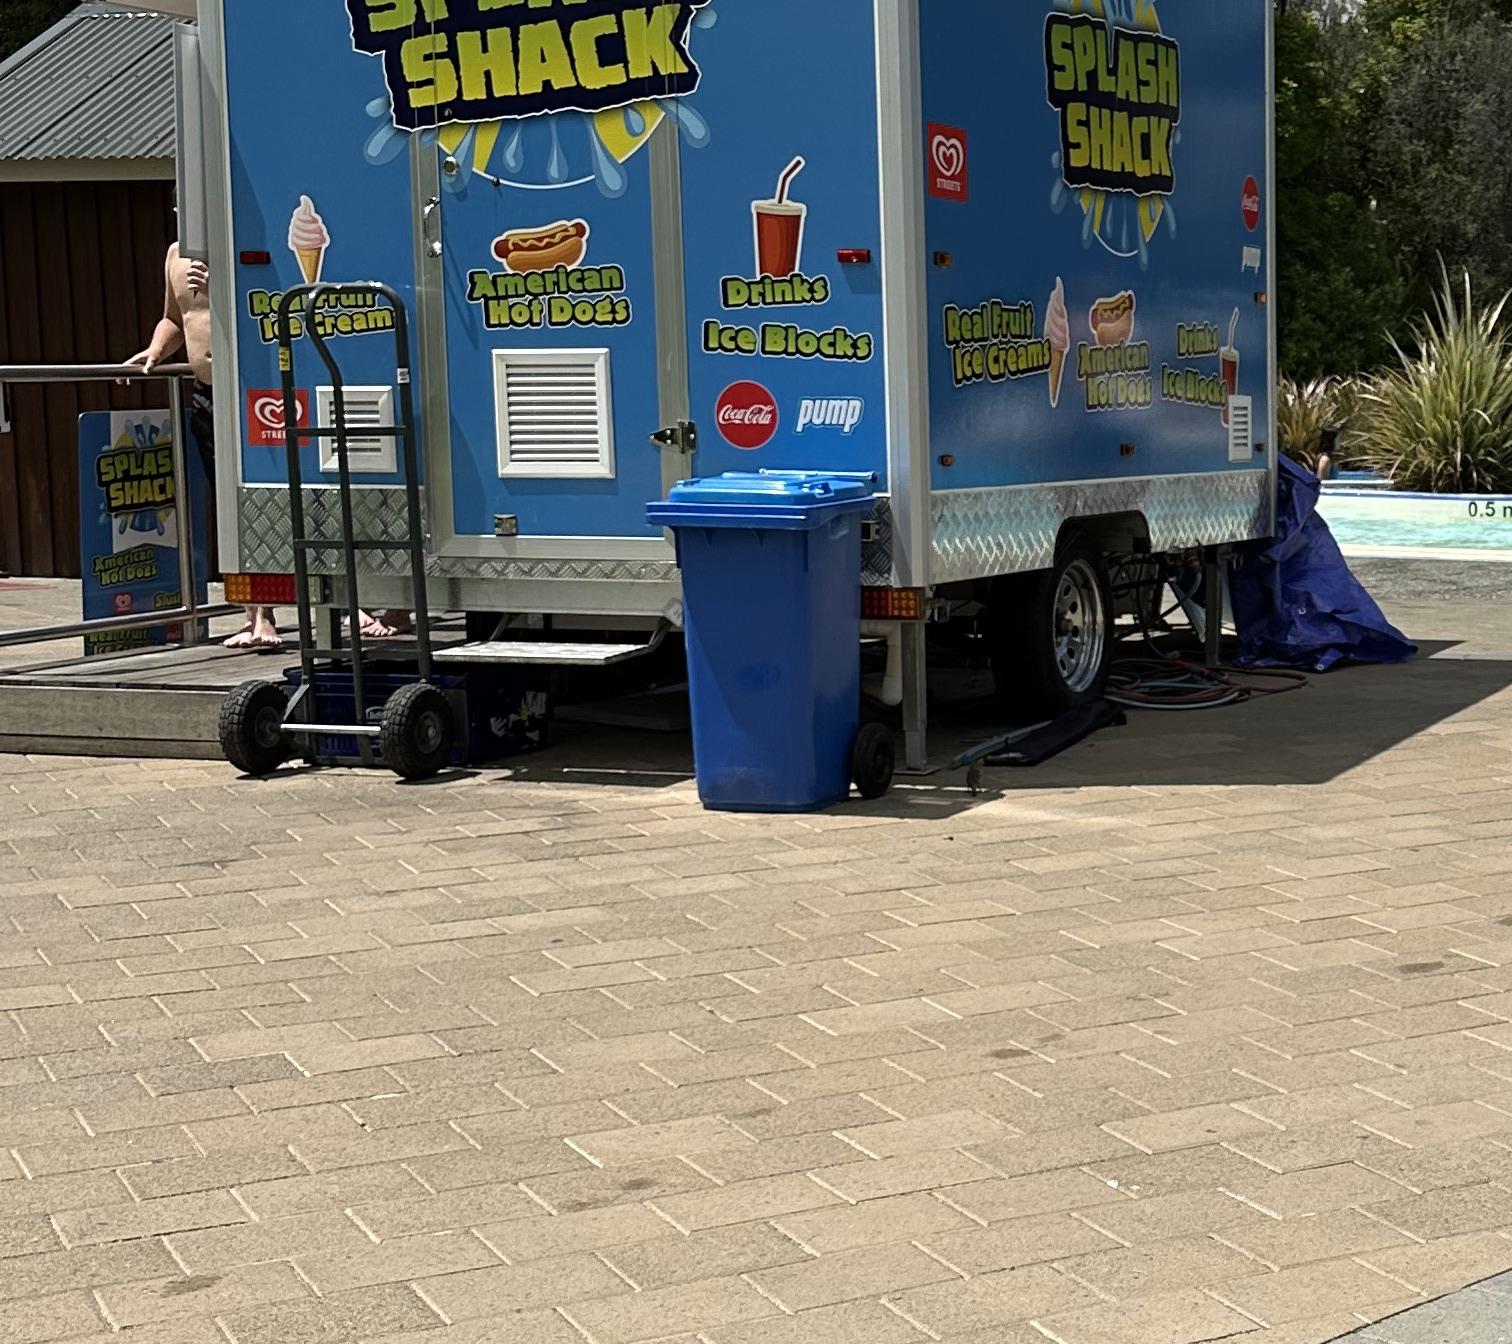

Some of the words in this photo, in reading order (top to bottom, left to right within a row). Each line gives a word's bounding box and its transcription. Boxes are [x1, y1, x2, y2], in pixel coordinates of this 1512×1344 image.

[401, 3, 689, 108] SHACK
[1051, 24, 1177, 107] SPLASH
[1067, 102, 1172, 177] SHACK
[472, 267, 623, 298] American
[726, 276, 827, 305] Drinks
[488, 298, 543, 325] Hot
[550, 297, 629, 323] Dogs
[948, 306, 989, 341] Real
[991, 303, 1034, 336] Fruit
[708, 322, 757, 351] Ice
[764, 325, 870, 357] Blocks
[954, 348, 985, 380] Ice
[987, 341, 1050, 376] Creams
[1080, 342, 1149, 375] American
[796, 399, 862, 433] pump
[100, 447, 173, 482] SPLAS
[1468, 501, 1496, 517] 0.5
